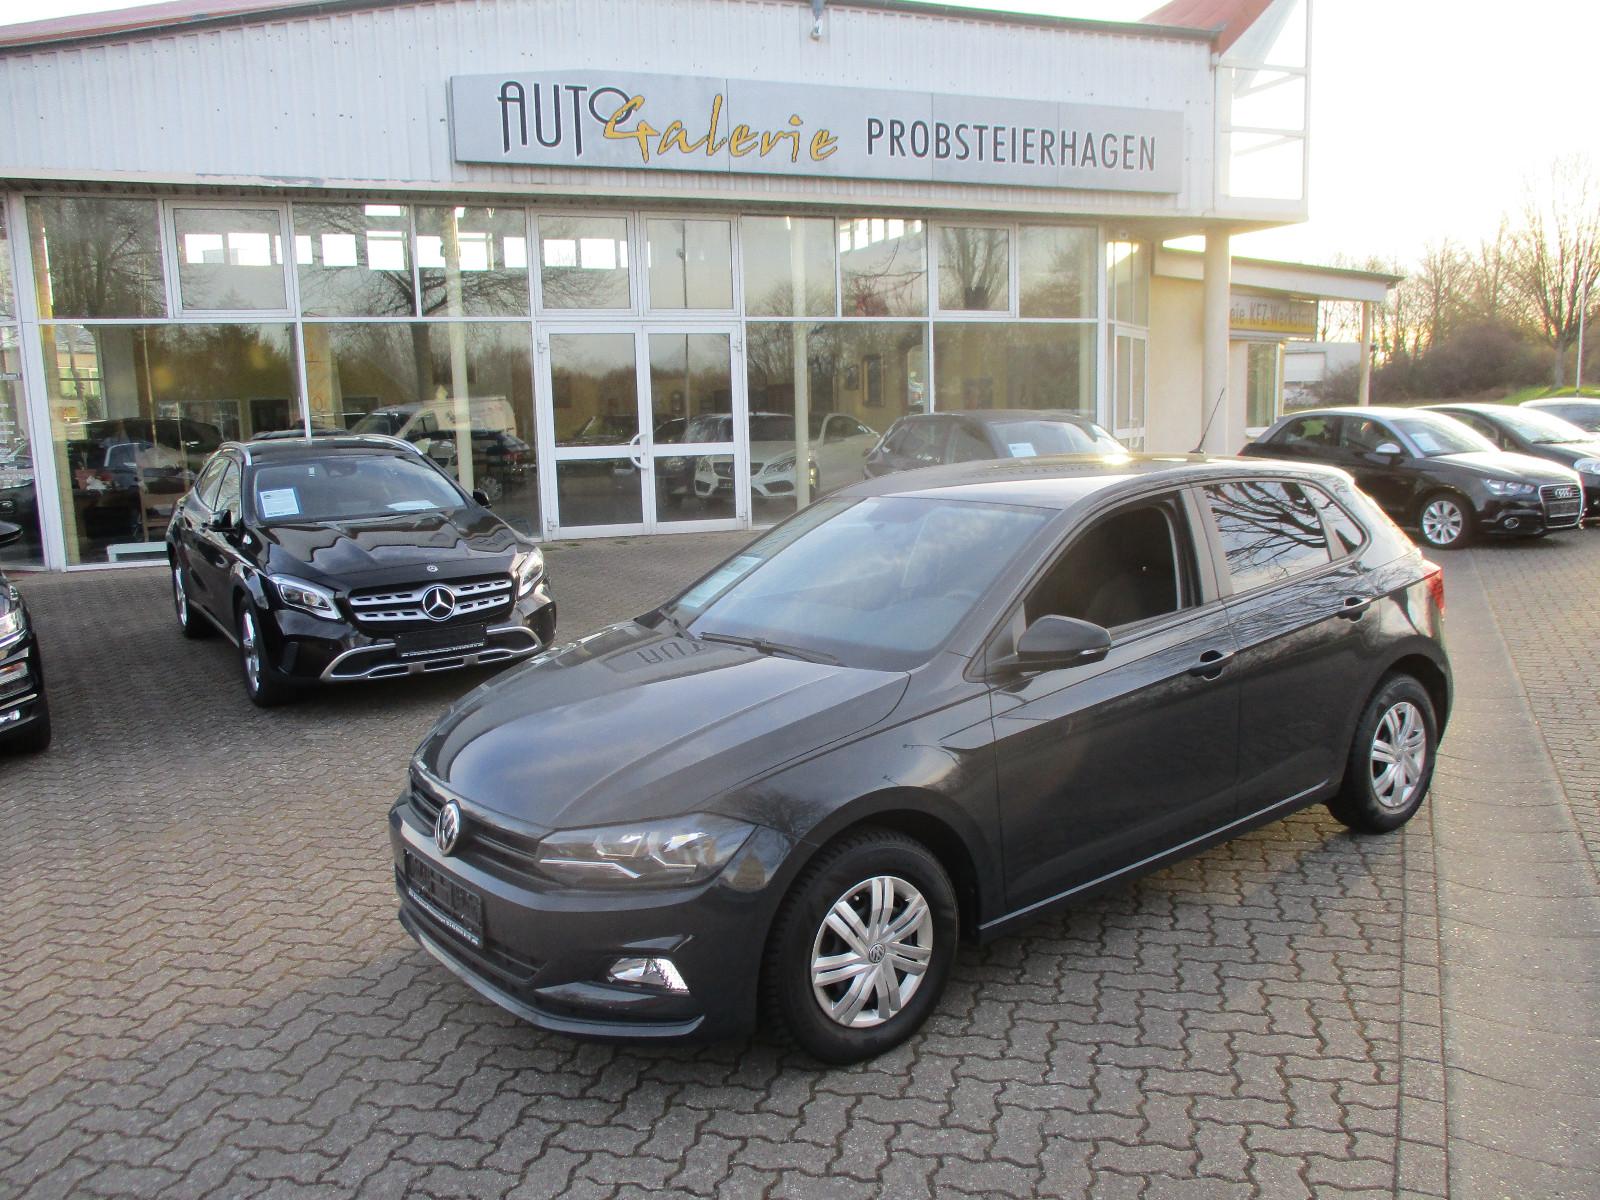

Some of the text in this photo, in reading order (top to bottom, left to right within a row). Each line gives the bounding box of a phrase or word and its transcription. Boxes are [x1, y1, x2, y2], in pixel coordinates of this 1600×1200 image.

[497, 80, 1156, 172] AUTO Galerie PROBSTEIERHAGEN
